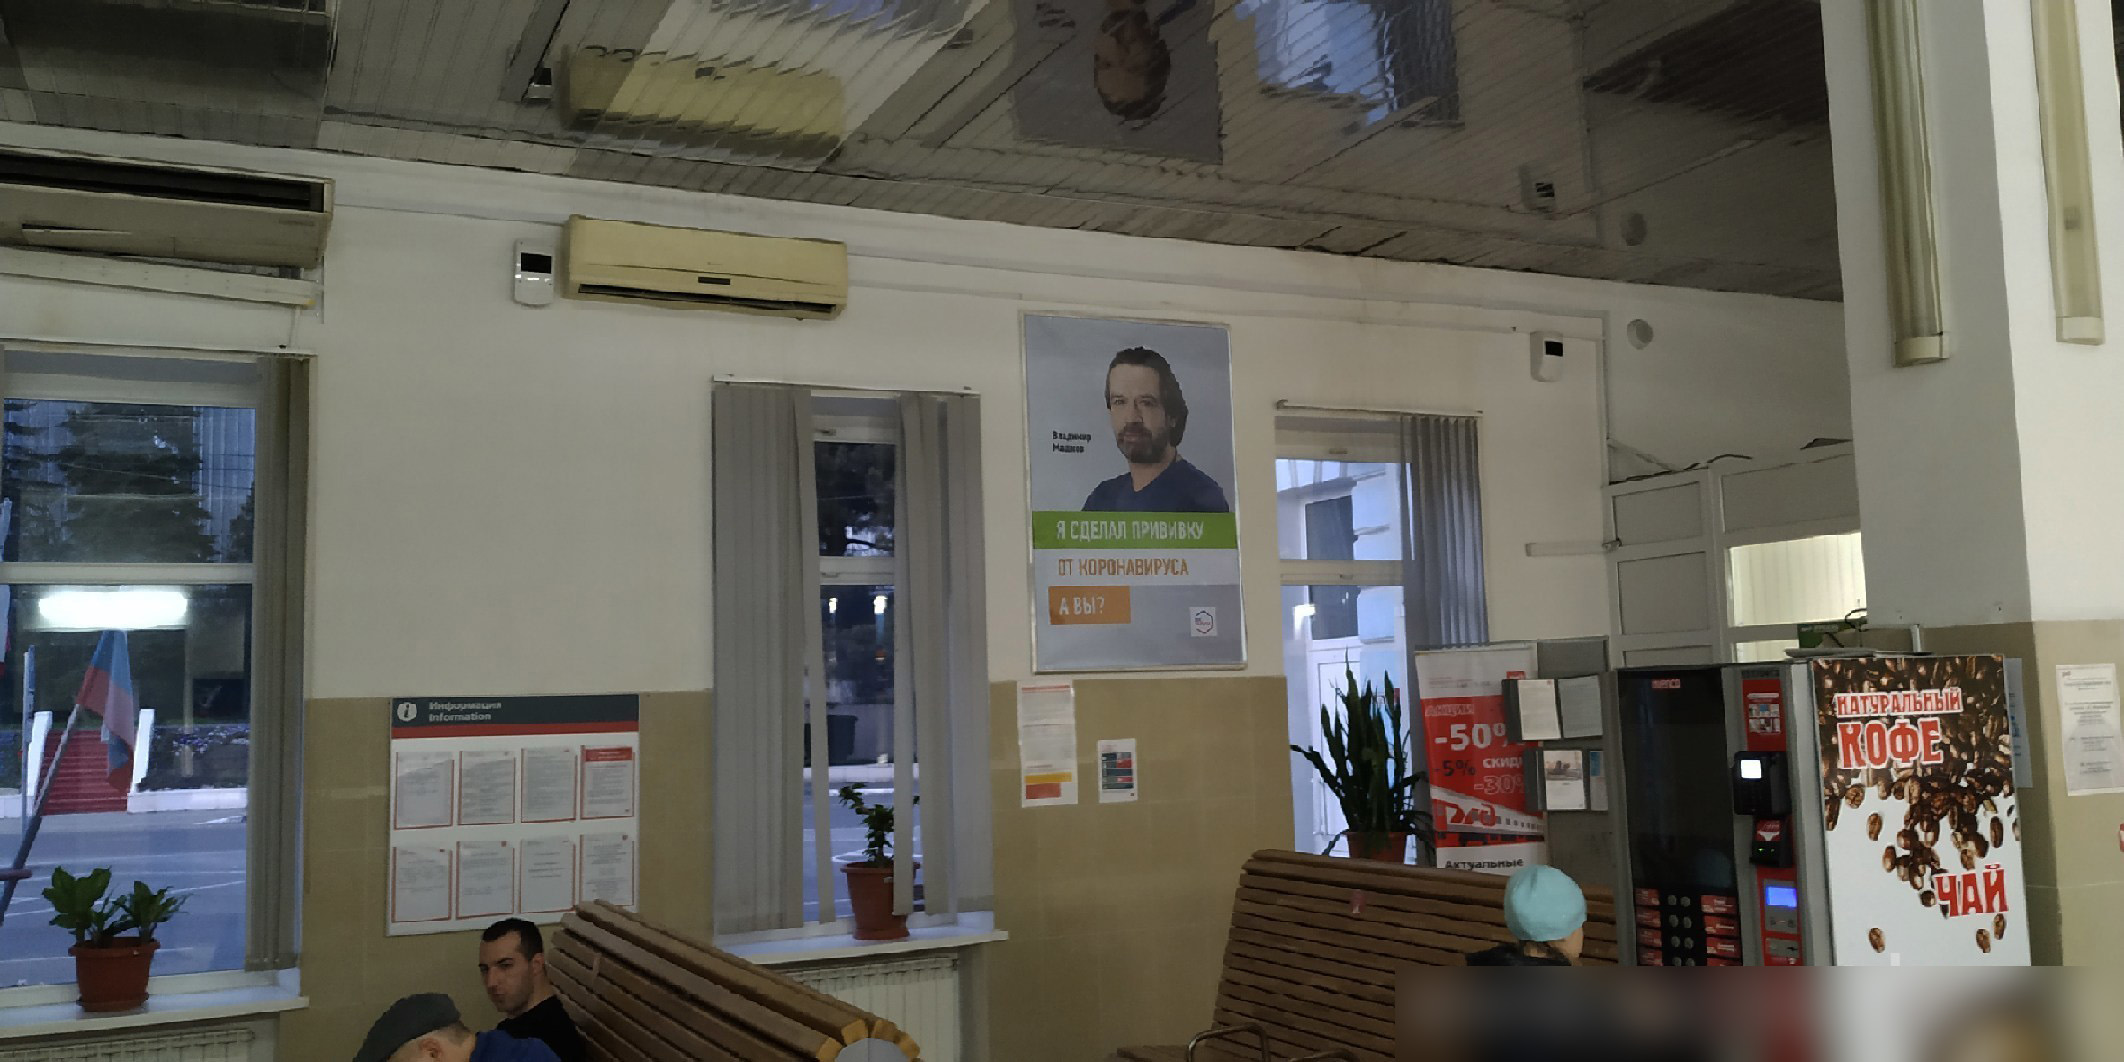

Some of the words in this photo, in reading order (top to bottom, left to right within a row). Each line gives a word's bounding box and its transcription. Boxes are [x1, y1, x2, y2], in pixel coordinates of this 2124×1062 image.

[1057, 520, 1066, 540] Я
[1070, 521, 1127, 542] СДЕЛАЛ
[1132, 521, 1204, 540] ПРИВИВКУ
[1058, 559, 1073, 576] ОТ
[1079, 558, 1189, 576] КОРОНАВИРУСА
[1059, 597, 1070, 615] А
[1073, 597, 1105, 615] ВЫ?
[1835, 688, 1962, 717] НАТУРАЛЬНЫЙ
[429, 712, 492, 721] Information
[1837, 718, 1943, 769] КОФЕ
[1445, 859, 1524, 871] Актуальные
[1934, 863, 2008, 917] ЧАЙ
